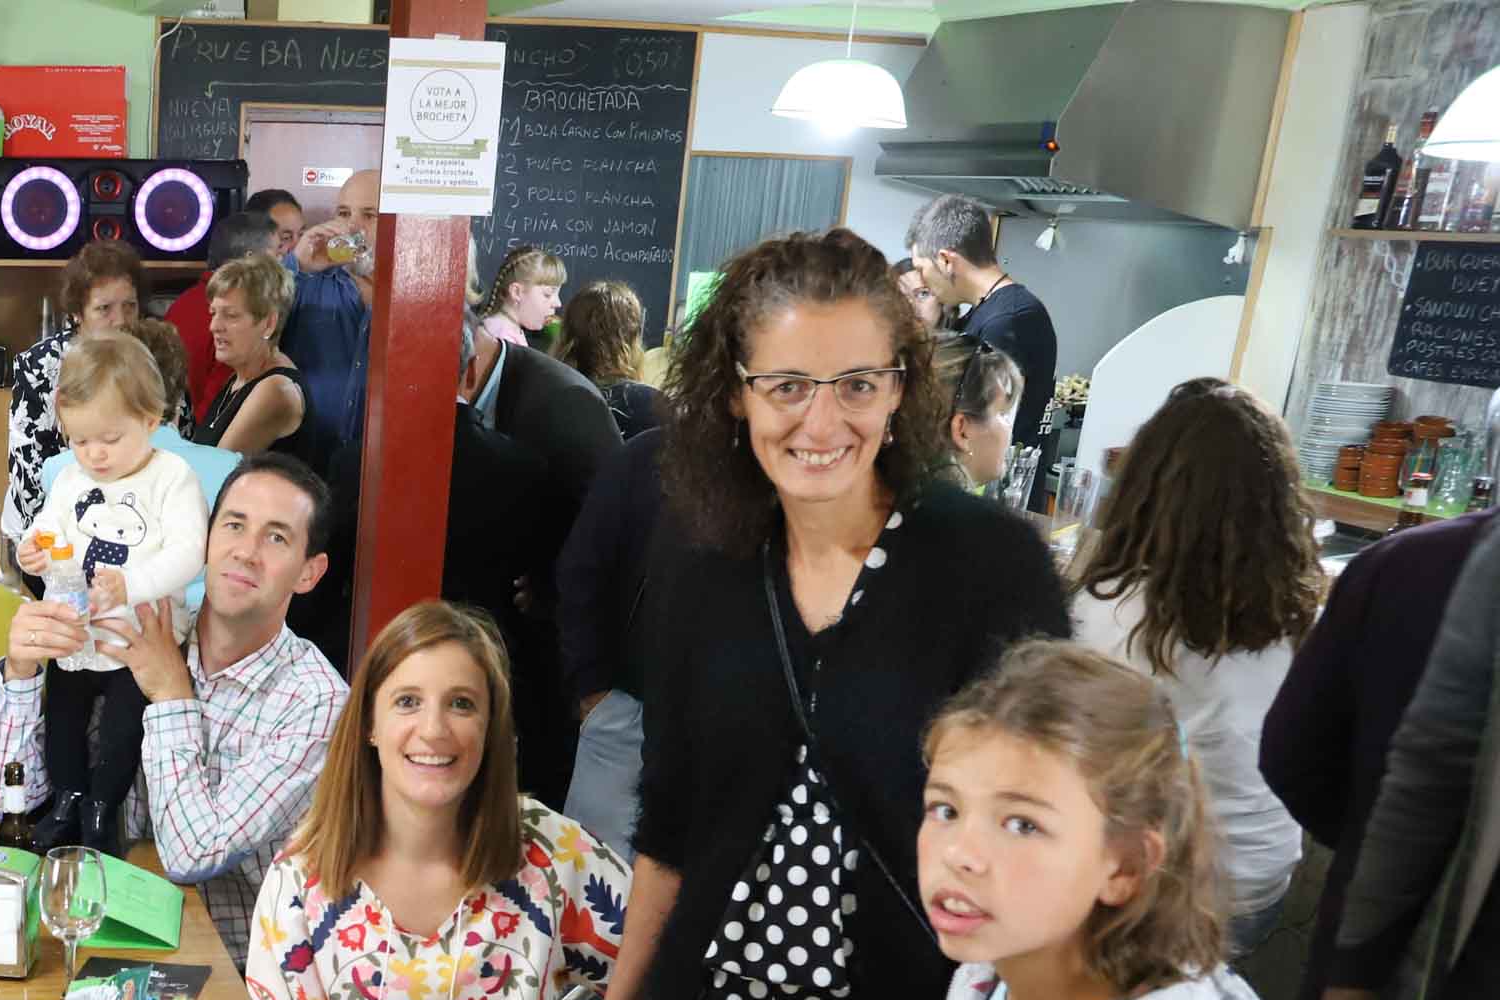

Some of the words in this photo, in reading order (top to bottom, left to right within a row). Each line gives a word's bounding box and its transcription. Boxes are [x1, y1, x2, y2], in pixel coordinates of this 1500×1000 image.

[171, 27, 302, 68] PRUEBA
[320, 37, 388, 70] NUES
[427, 88, 452, 97] VOTA
[454, 88, 461, 97] A
[523, 90, 640, 112] BROCHETADA
[169, 98, 231, 118] NUEVA
[419, 100, 432, 109] LA
[435, 100, 467, 109] MEJOR
[416, 112, 468, 122] BROCHETA
[524, 123, 557, 138] BOLA
[561, 118, 601, 139] CARNE
[525, 157, 573, 173] PULPO
[583, 158, 660, 174] PLANCHA
[528, 186, 577, 202] POLLO
[585, 190, 655, 208] PLANCHA
[565, 220, 594, 233] CON
